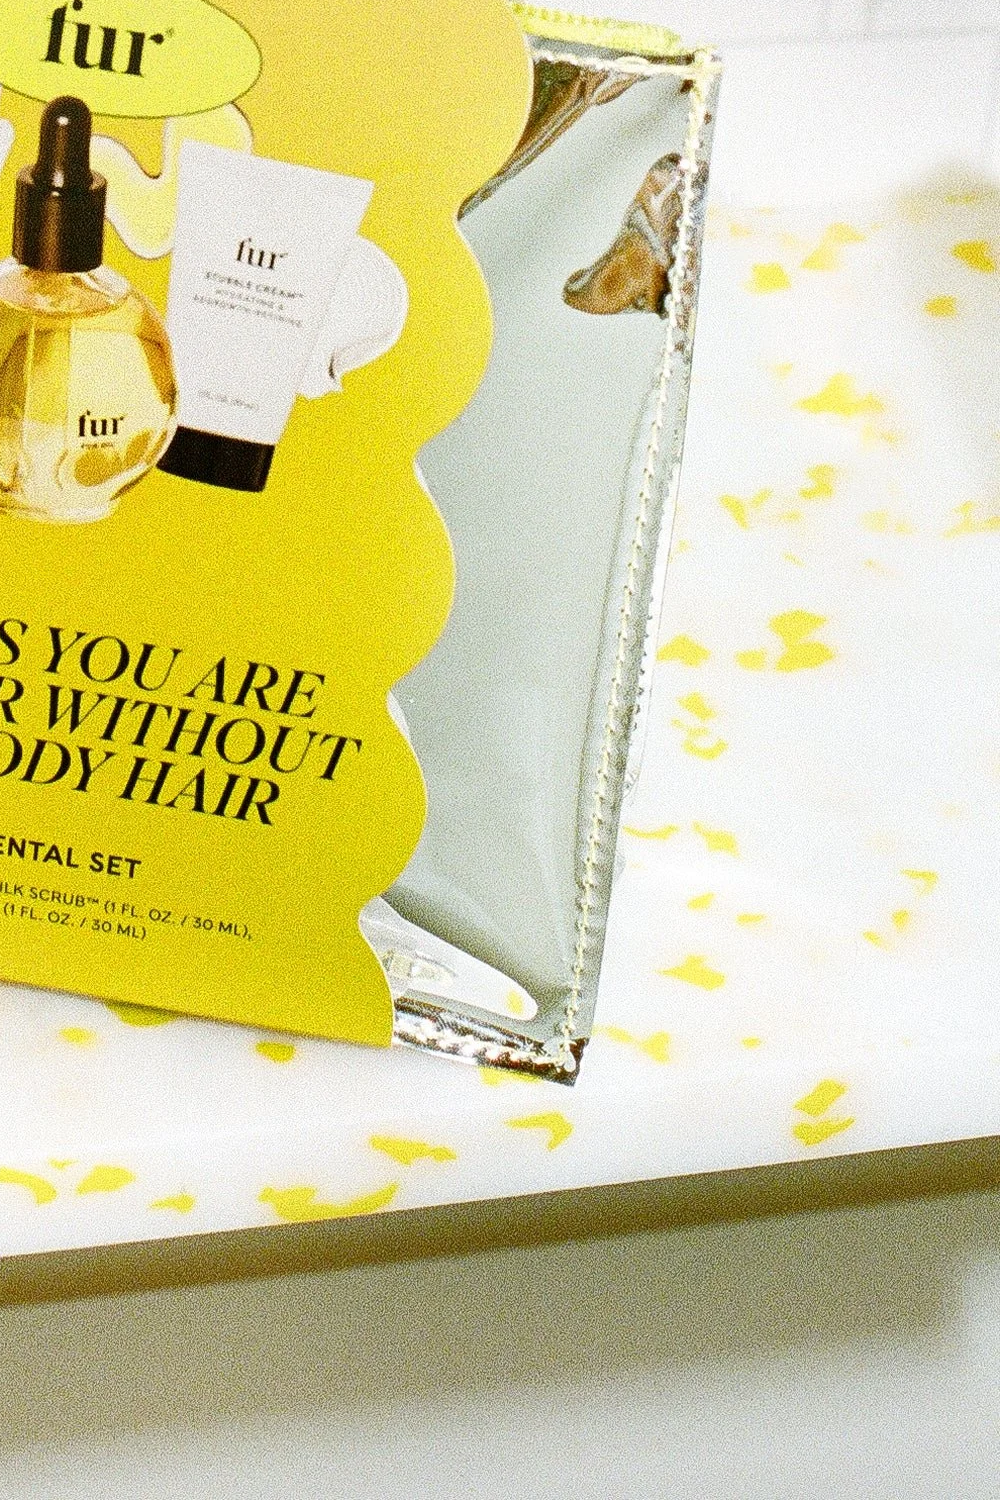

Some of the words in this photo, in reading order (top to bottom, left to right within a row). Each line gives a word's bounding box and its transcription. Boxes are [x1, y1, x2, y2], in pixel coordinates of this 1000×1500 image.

[235, 237, 287, 270] fur
[78, 408, 125, 437] fur
[43, 626, 183, 691] YOU
[183, 656, 326, 718] ARE
[47, 684, 363, 781] WITHOUT
[118, 756, 281, 826] HAIR
[89, 851, 142, 879] SET
[3, 901, 16, 917] (1
[20, 905, 43, 921] FL.
[47, 910, 75, 928] OZ.
[91, 918, 112, 933] 30
[116, 922, 147, 941] ML)
[103, 899, 117, 915] (1
[121, 902, 144, 919] FL.
[149, 908, 176, 925] OZ.
[192, 916, 214, 931] 30
